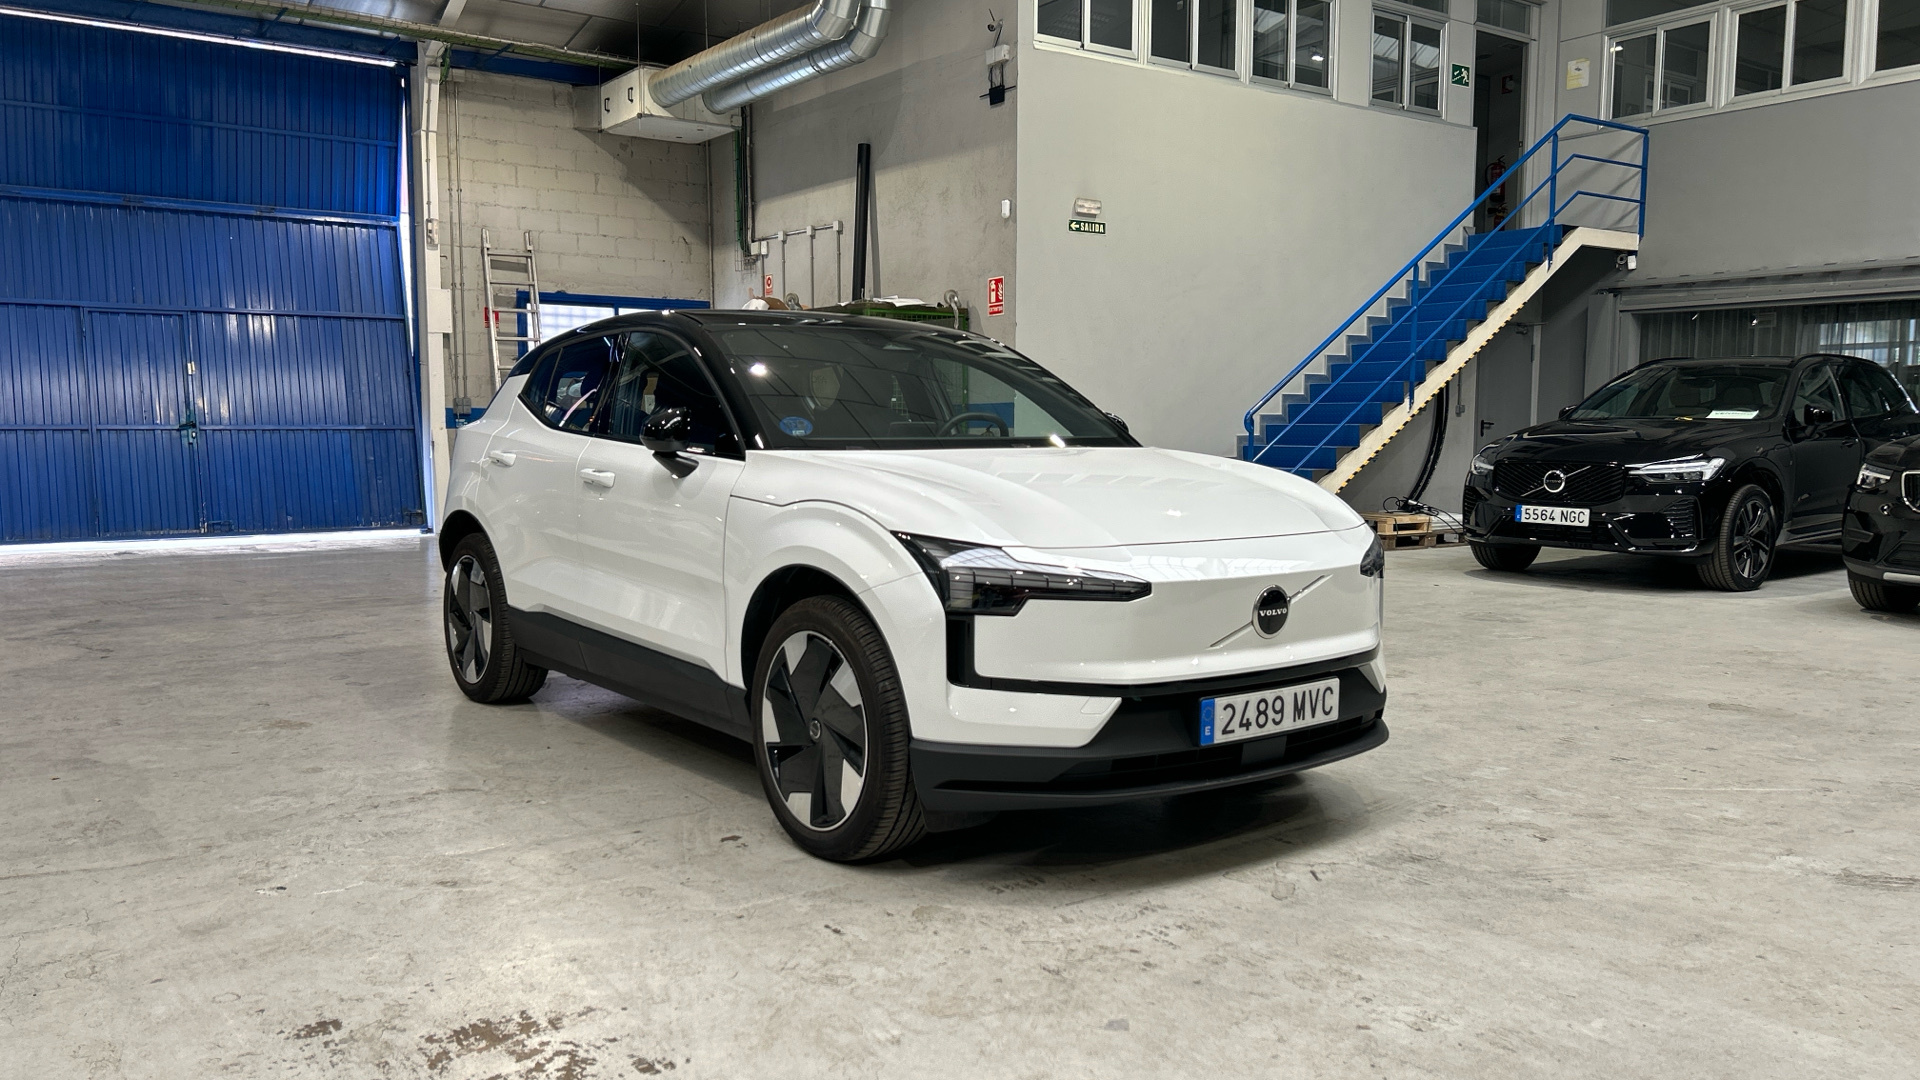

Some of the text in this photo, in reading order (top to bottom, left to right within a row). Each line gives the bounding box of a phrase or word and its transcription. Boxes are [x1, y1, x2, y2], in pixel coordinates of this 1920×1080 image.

[1080, 222, 1104, 233] SALIDA
[1524, 508, 1586, 524] 5564 NGC
[1259, 607, 1288, 617] VOLVO
[1221, 686, 1334, 736] 2489 MVC
[1204, 725, 1211, 736] E
